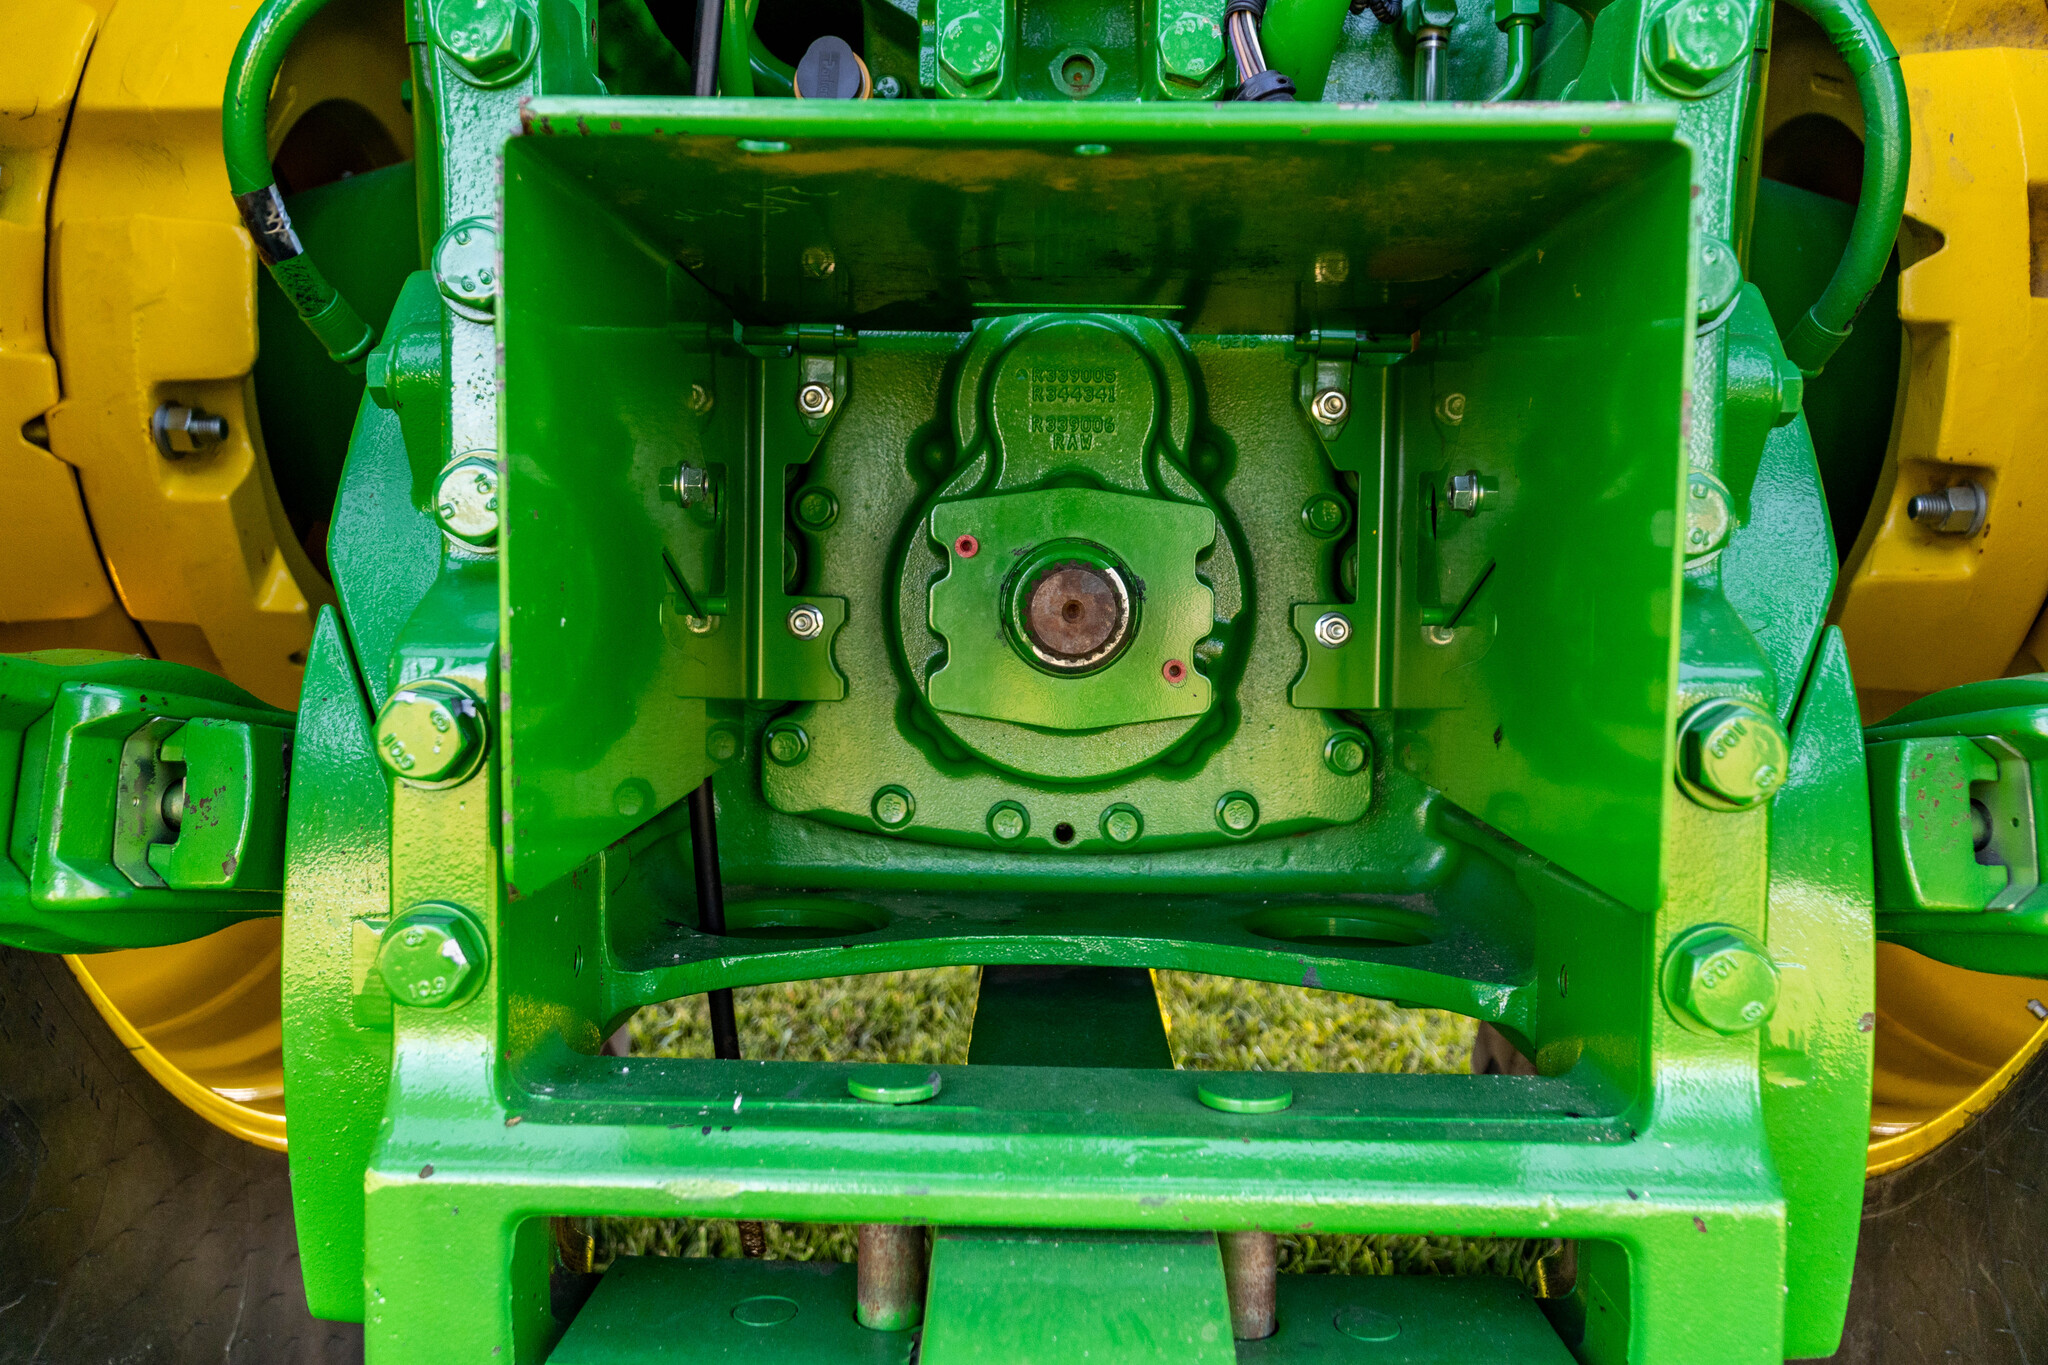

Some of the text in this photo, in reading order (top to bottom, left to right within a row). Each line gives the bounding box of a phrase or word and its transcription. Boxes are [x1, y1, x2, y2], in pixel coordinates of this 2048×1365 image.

[1031, 367, 1117, 383] R339005
[1031, 385, 1117, 402] R344341
[1031, 415, 1116, 433] R339006
[1052, 433, 1093, 451] RAW
